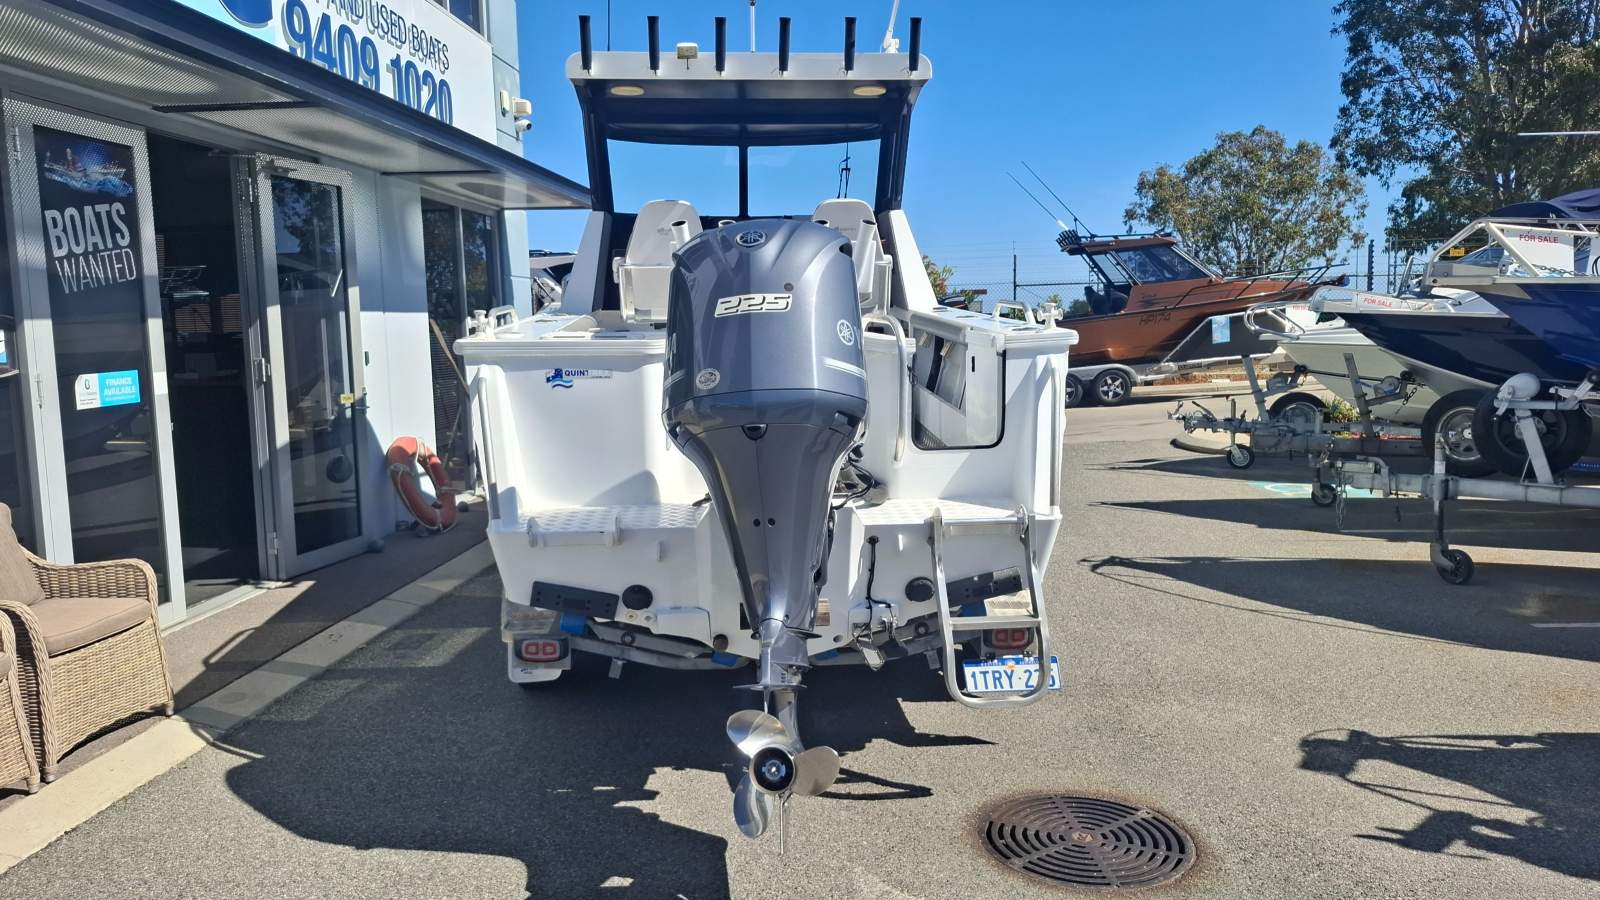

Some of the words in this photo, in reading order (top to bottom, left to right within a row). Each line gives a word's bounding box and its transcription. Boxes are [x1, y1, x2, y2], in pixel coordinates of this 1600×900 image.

[371, 0, 407, 45] USED
[411, 23, 450, 71] BOATS
[285, 0, 381, 93] 9409
[389, 53, 453, 126] 1020
[44, 202, 131, 258] BOATS
[1519, 234, 1536, 242] FOR
[1537, 235, 1559, 244] SALE
[55, 248, 137, 294] WANTED
[715, 293, 792, 317] 225
[1363, 297, 1377, 305] FOR
[1378, 299, 1393, 308] SALE
[104, 385, 136, 395] AVAILABLE
[105, 376, 133, 387] FINANCE
